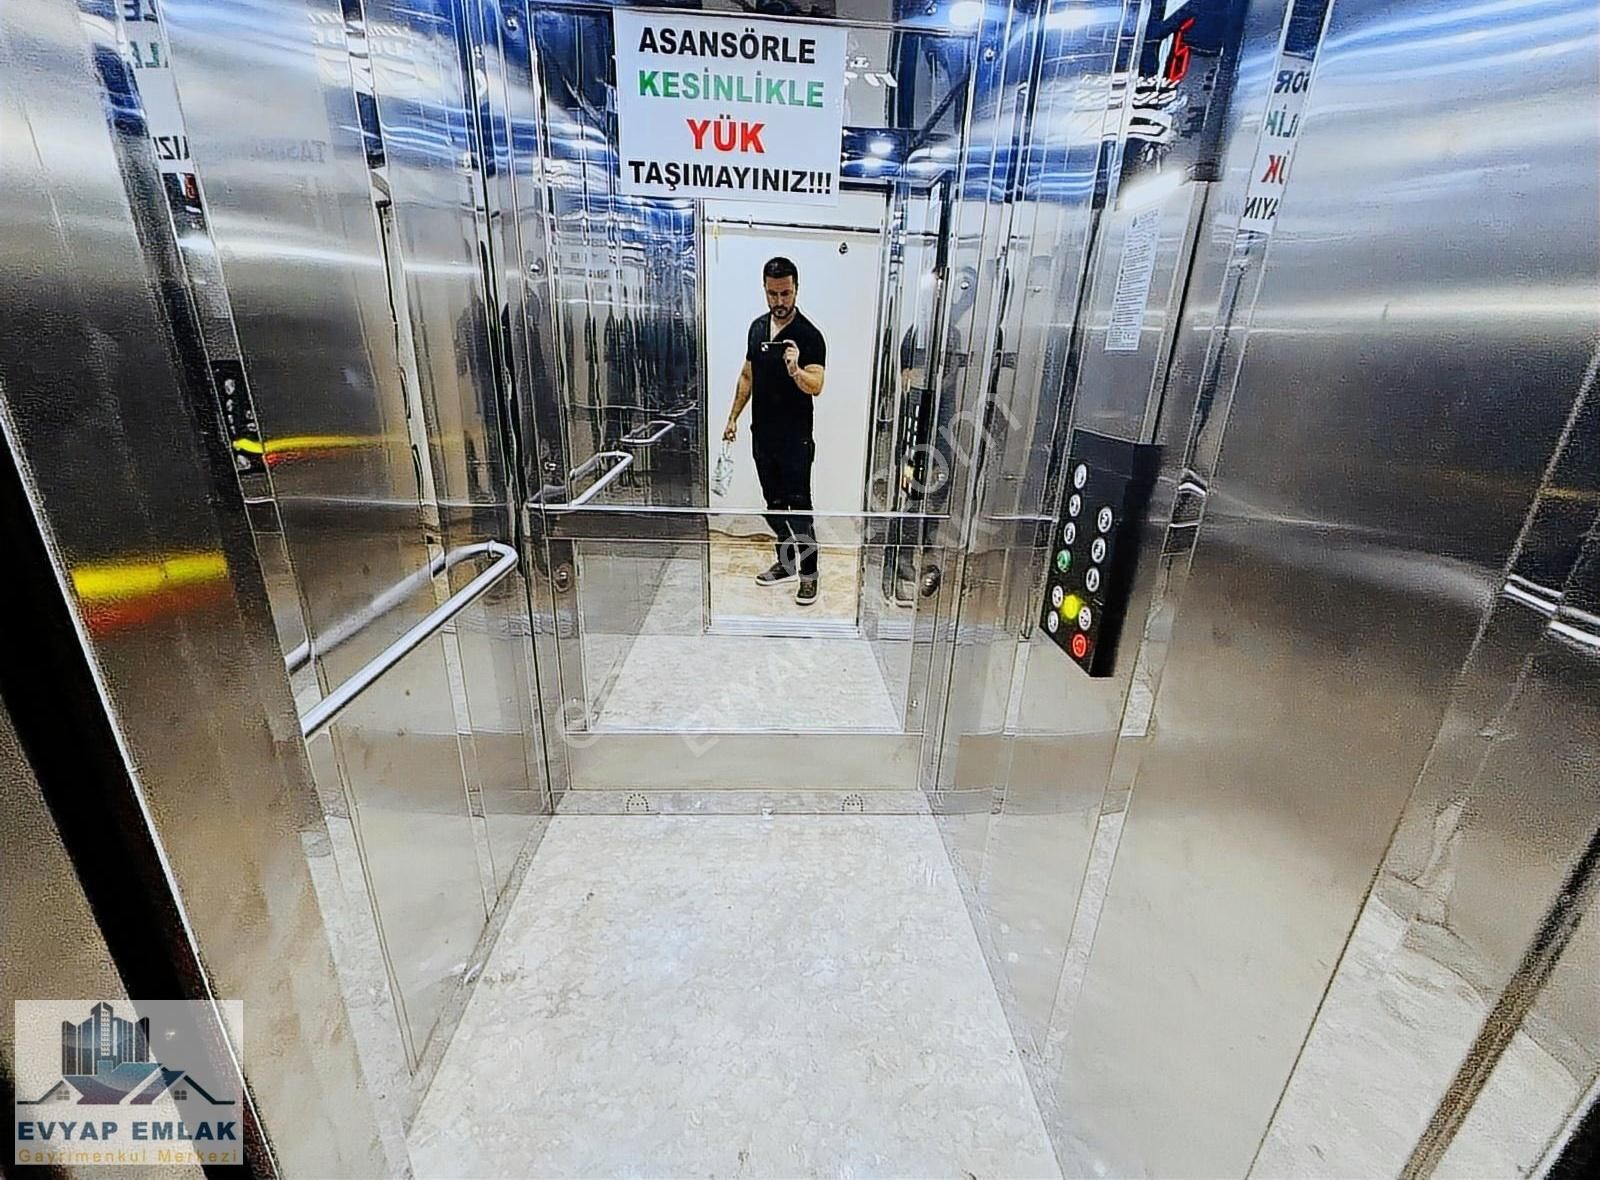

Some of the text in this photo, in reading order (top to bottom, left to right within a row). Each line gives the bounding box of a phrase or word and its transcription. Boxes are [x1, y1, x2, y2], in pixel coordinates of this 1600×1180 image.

[638, 26, 816, 64] ASANSÖRLE
[638, 67, 825, 108] KESİNLİKLE
[686, 113, 765, 154] YÜK
[628, 160, 832, 195] TAŞIMAYINIZ!!!
